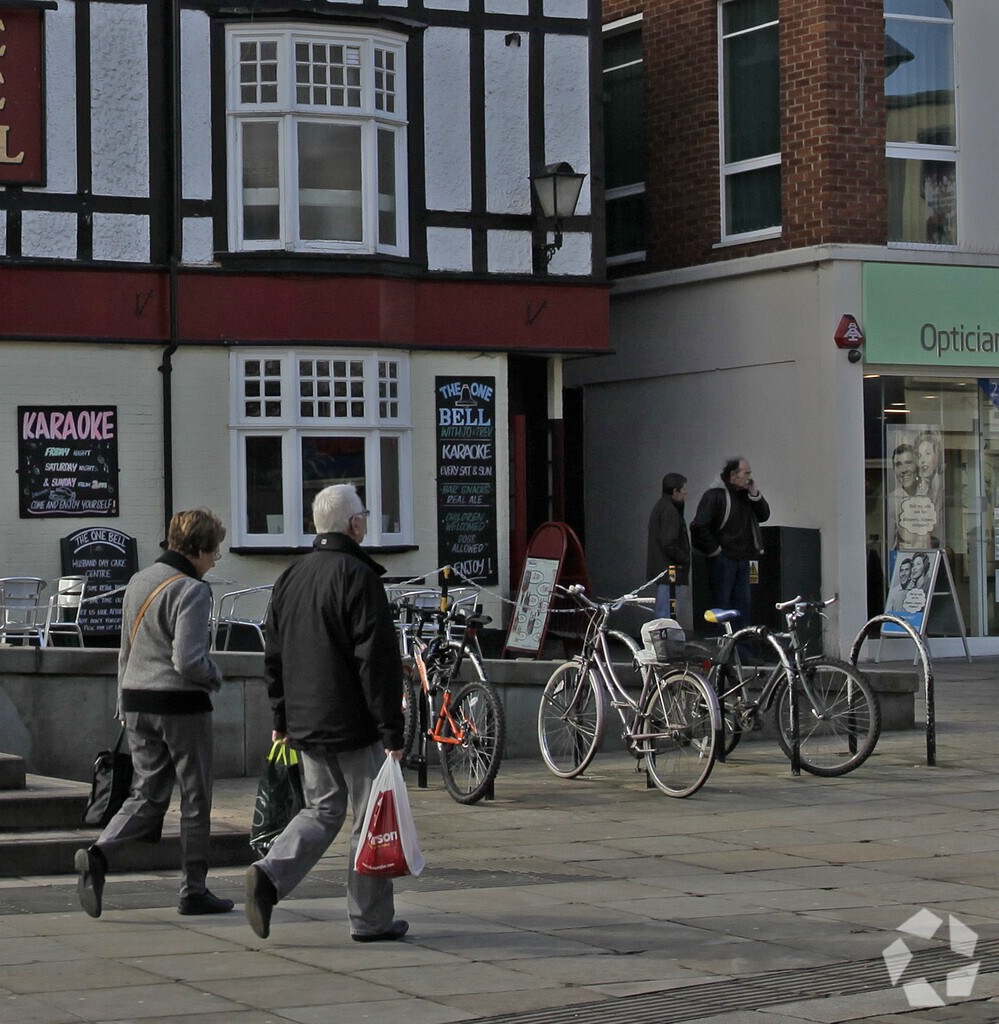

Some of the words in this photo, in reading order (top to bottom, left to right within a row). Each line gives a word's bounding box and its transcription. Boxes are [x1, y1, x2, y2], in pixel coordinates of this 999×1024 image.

[439, 382, 461, 399] THE
[470, 382, 494, 402] ONE
[439, 407, 491, 426] BELL
[23, 410, 114, 440] KARAOKE
[441, 426, 460, 437] WITH
[44, 447, 71, 457] FRIDAY
[442, 443, 492, 460] KARAOKE
[44, 462, 78, 472] SATURDAY
[440, 466, 459, 476] EVERY
[459, 466, 472, 476] SAT
[472, 466, 478, 475] &
[43, 478, 50, 487] &
[51, 478, 77, 487] SUNDAY
[31, 500, 45, 509] COME
[45, 500, 59, 509] AND
[59, 500, 81, 509] ENJOY
[446, 495, 466, 504] REAL
[469, 495, 483, 504] ALE
[75, 533, 89, 546] THE
[91, 530, 106, 540] ONE
[108, 533, 126, 547] BELL
[98, 559, 110, 567] DAY
[110, 558, 127, 567] CARE
[85, 569, 112, 578] CENTRE
